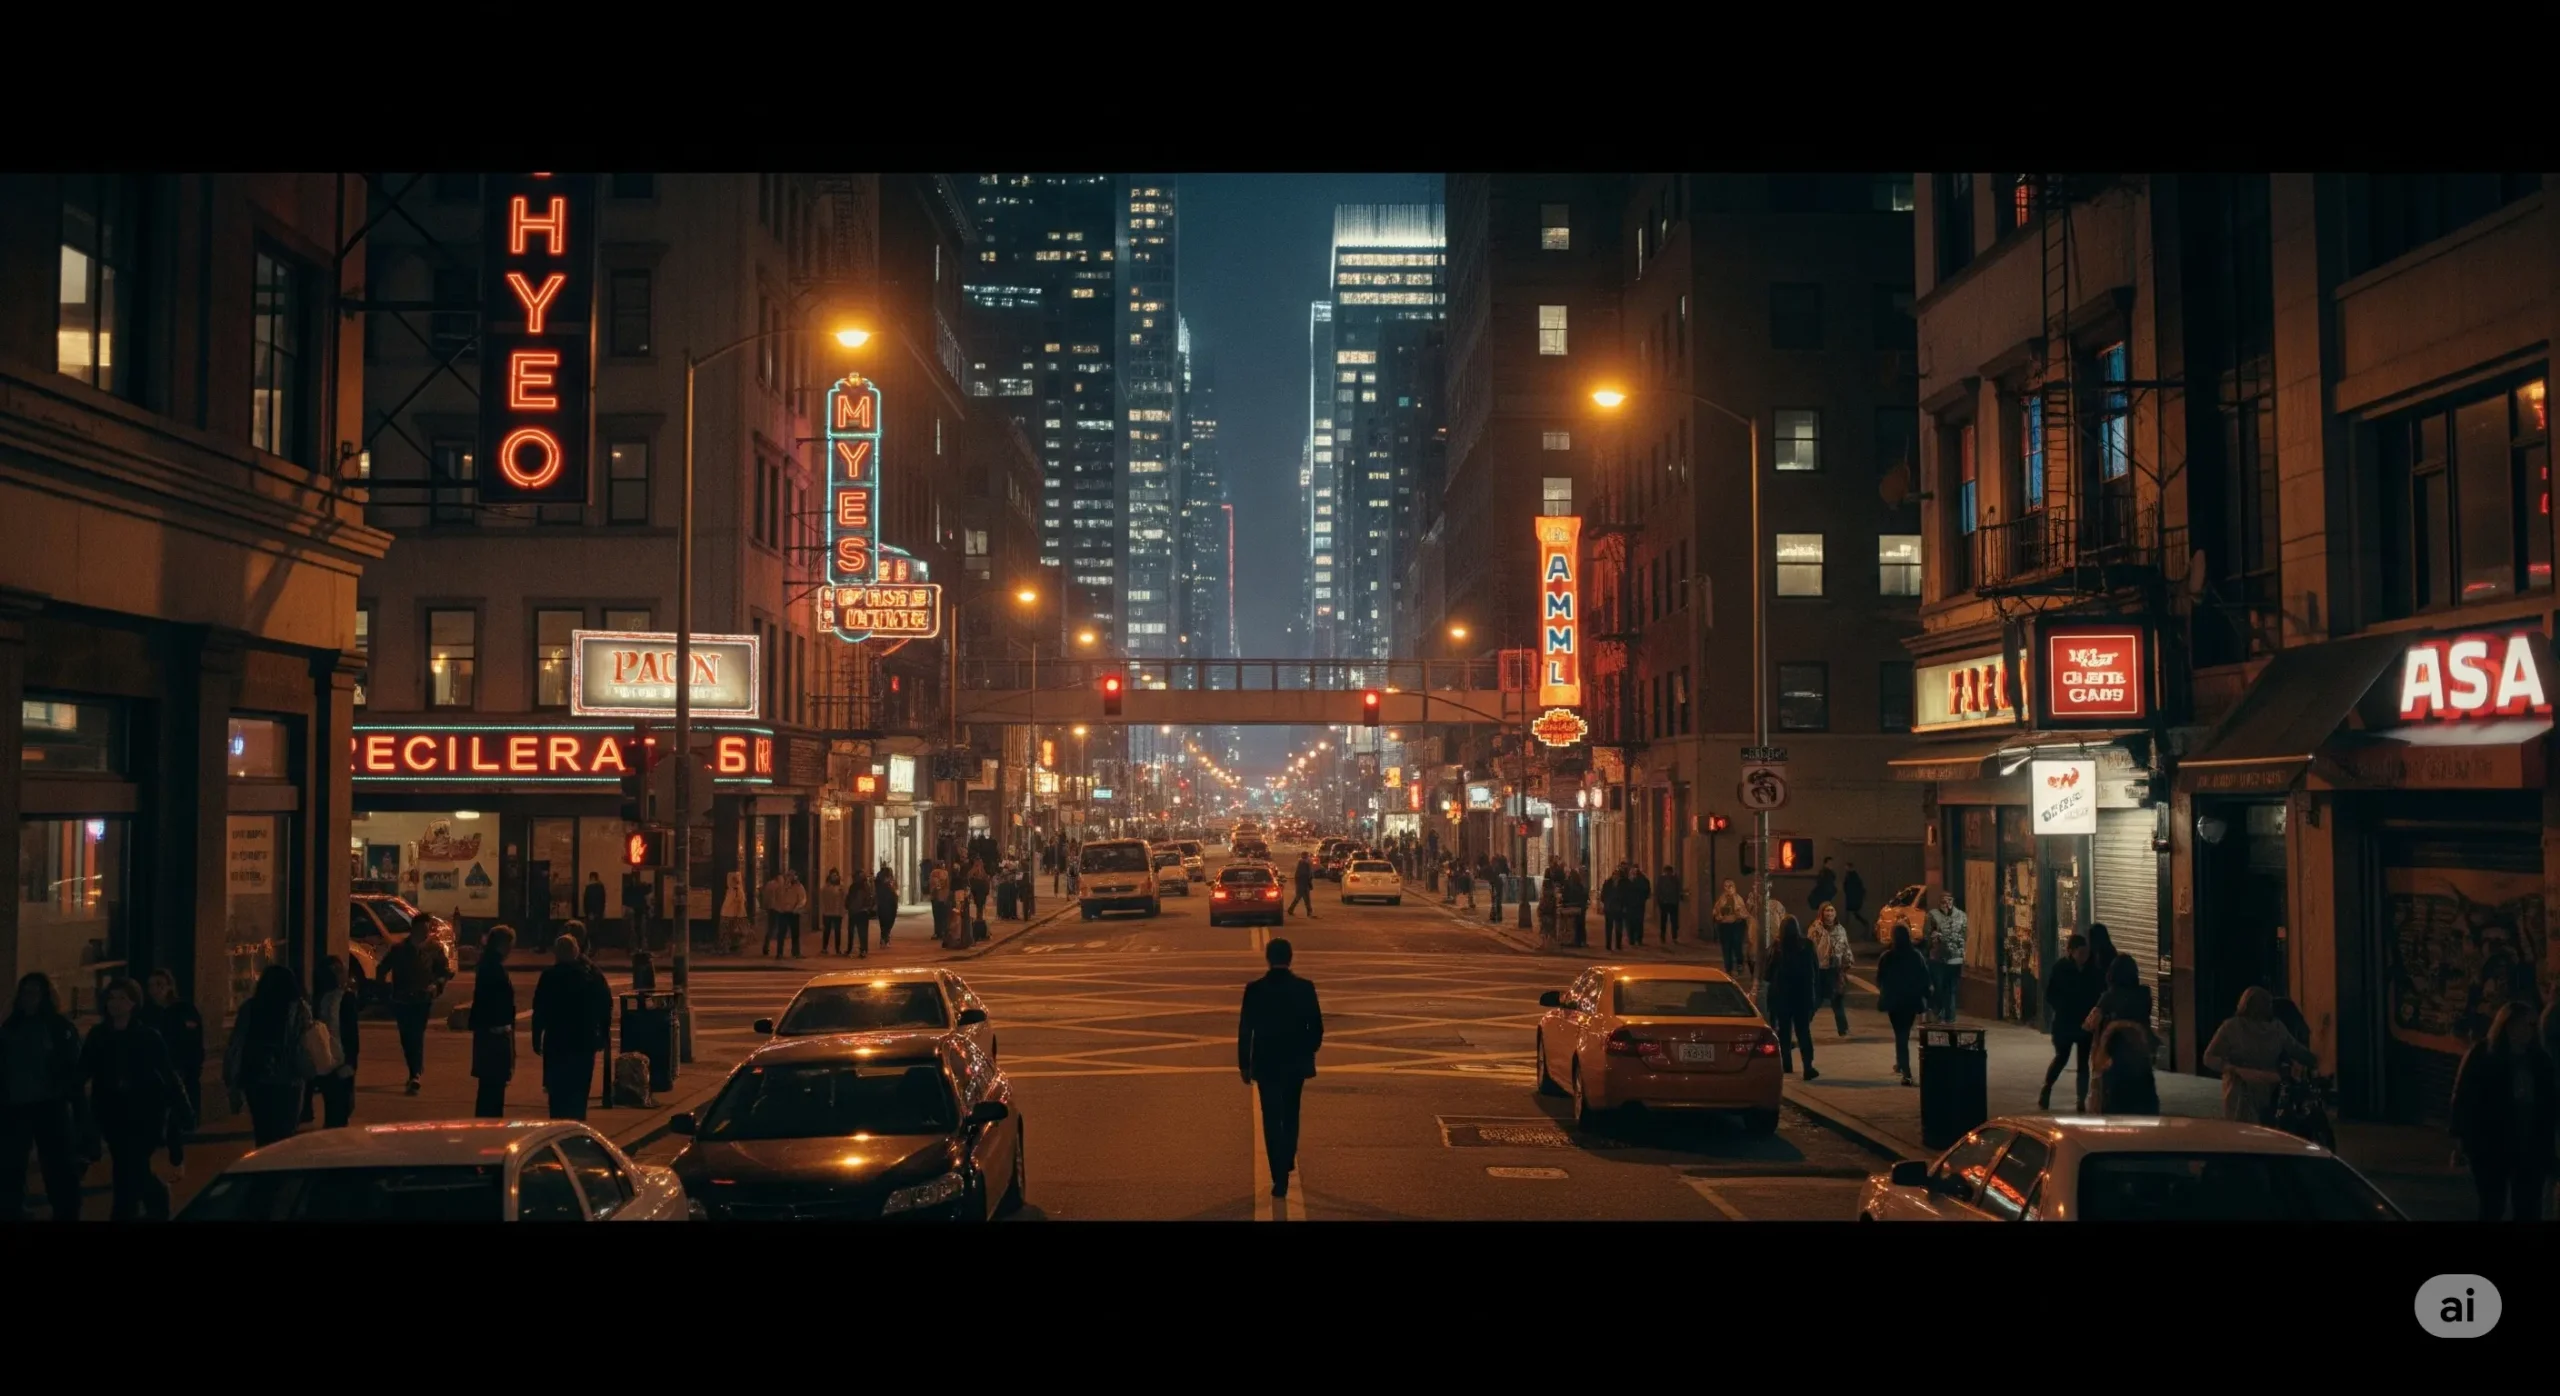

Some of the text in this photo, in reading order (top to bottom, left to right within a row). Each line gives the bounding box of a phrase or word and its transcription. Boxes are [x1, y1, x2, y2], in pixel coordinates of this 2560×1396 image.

[501, 173, 565, 488] HYEO
[837, 394, 870, 573] MYES
[2400, 635, 2547, 714] ASA
